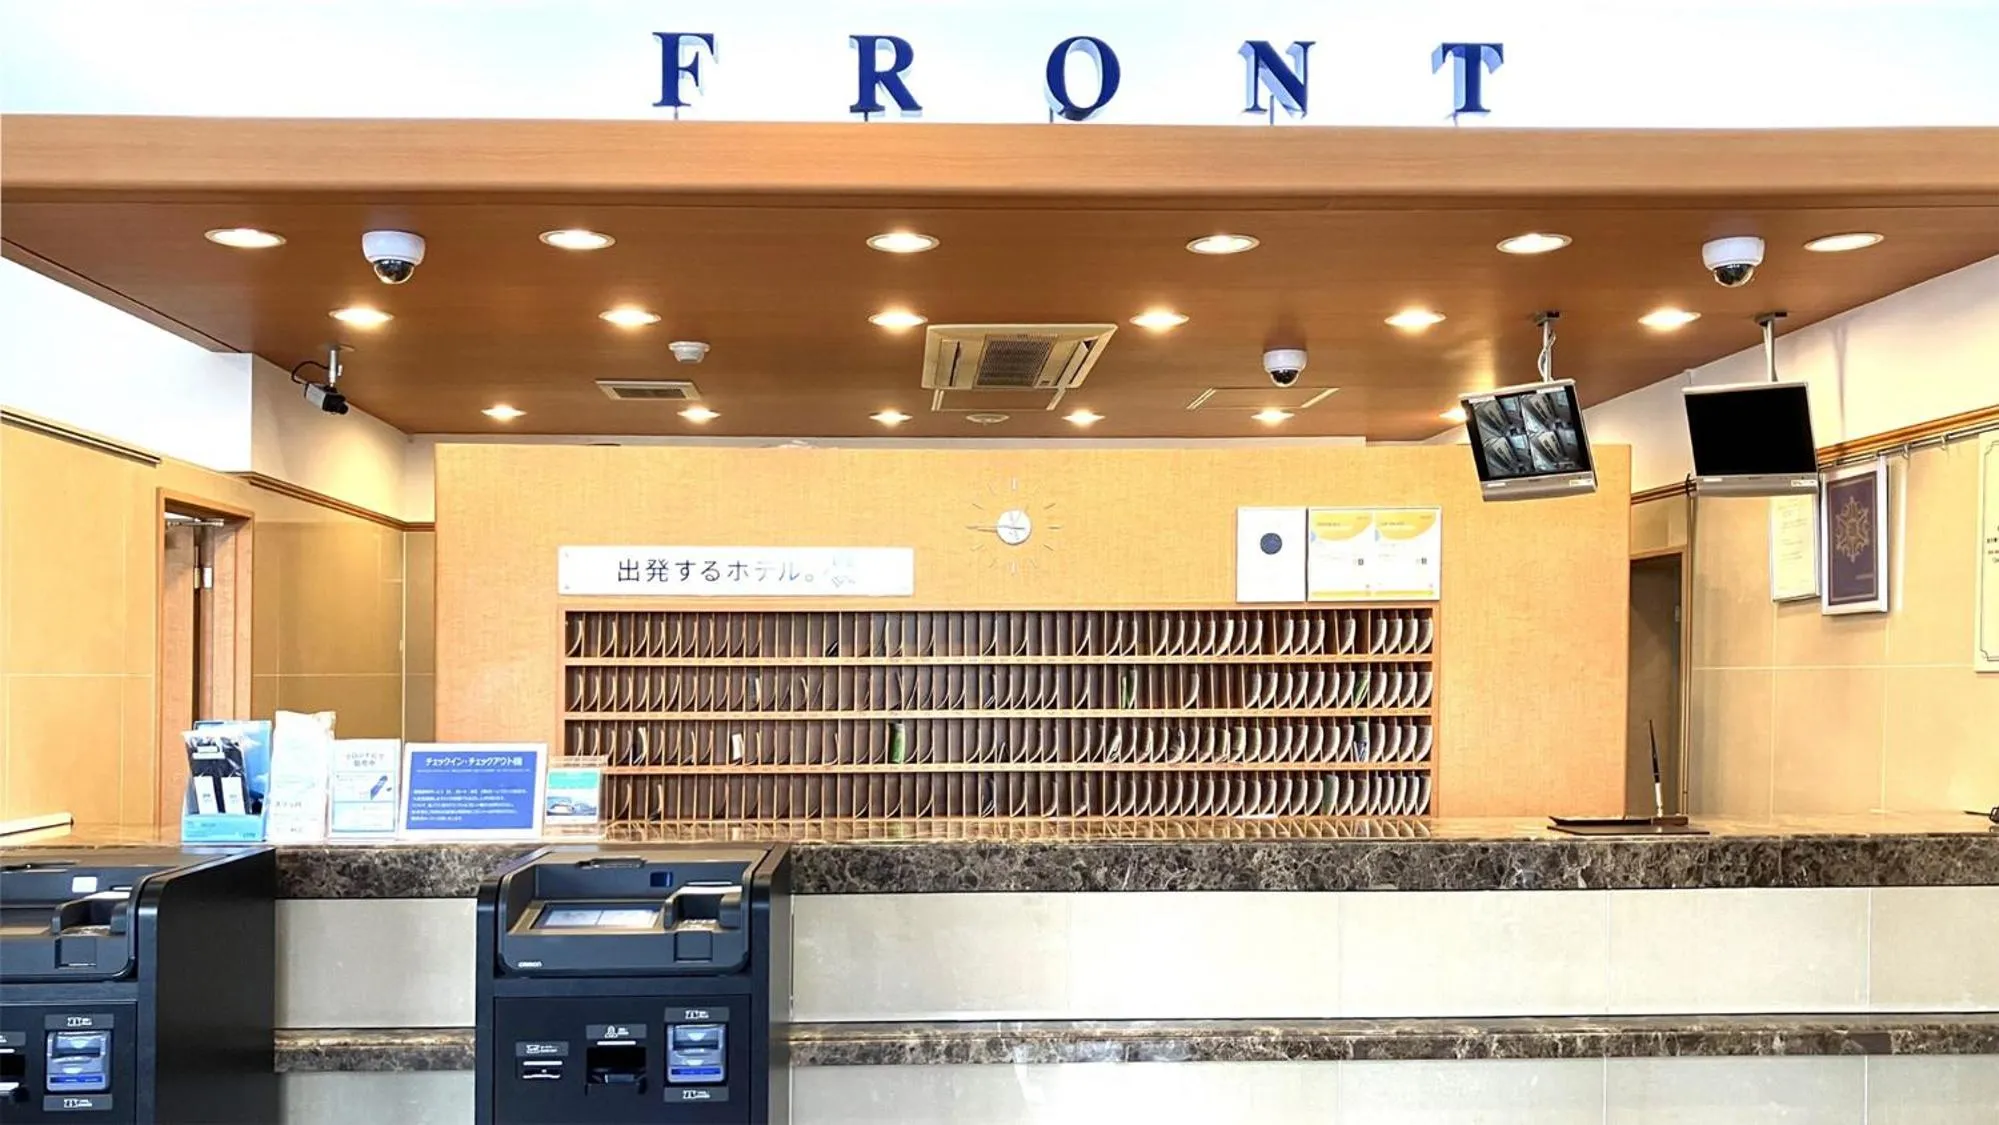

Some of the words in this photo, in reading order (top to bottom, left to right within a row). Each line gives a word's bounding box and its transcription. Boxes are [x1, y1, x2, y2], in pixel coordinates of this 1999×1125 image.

[652, 32, 1504, 119] FRONT
[617, 558, 815, 582] 出発するホテル。
